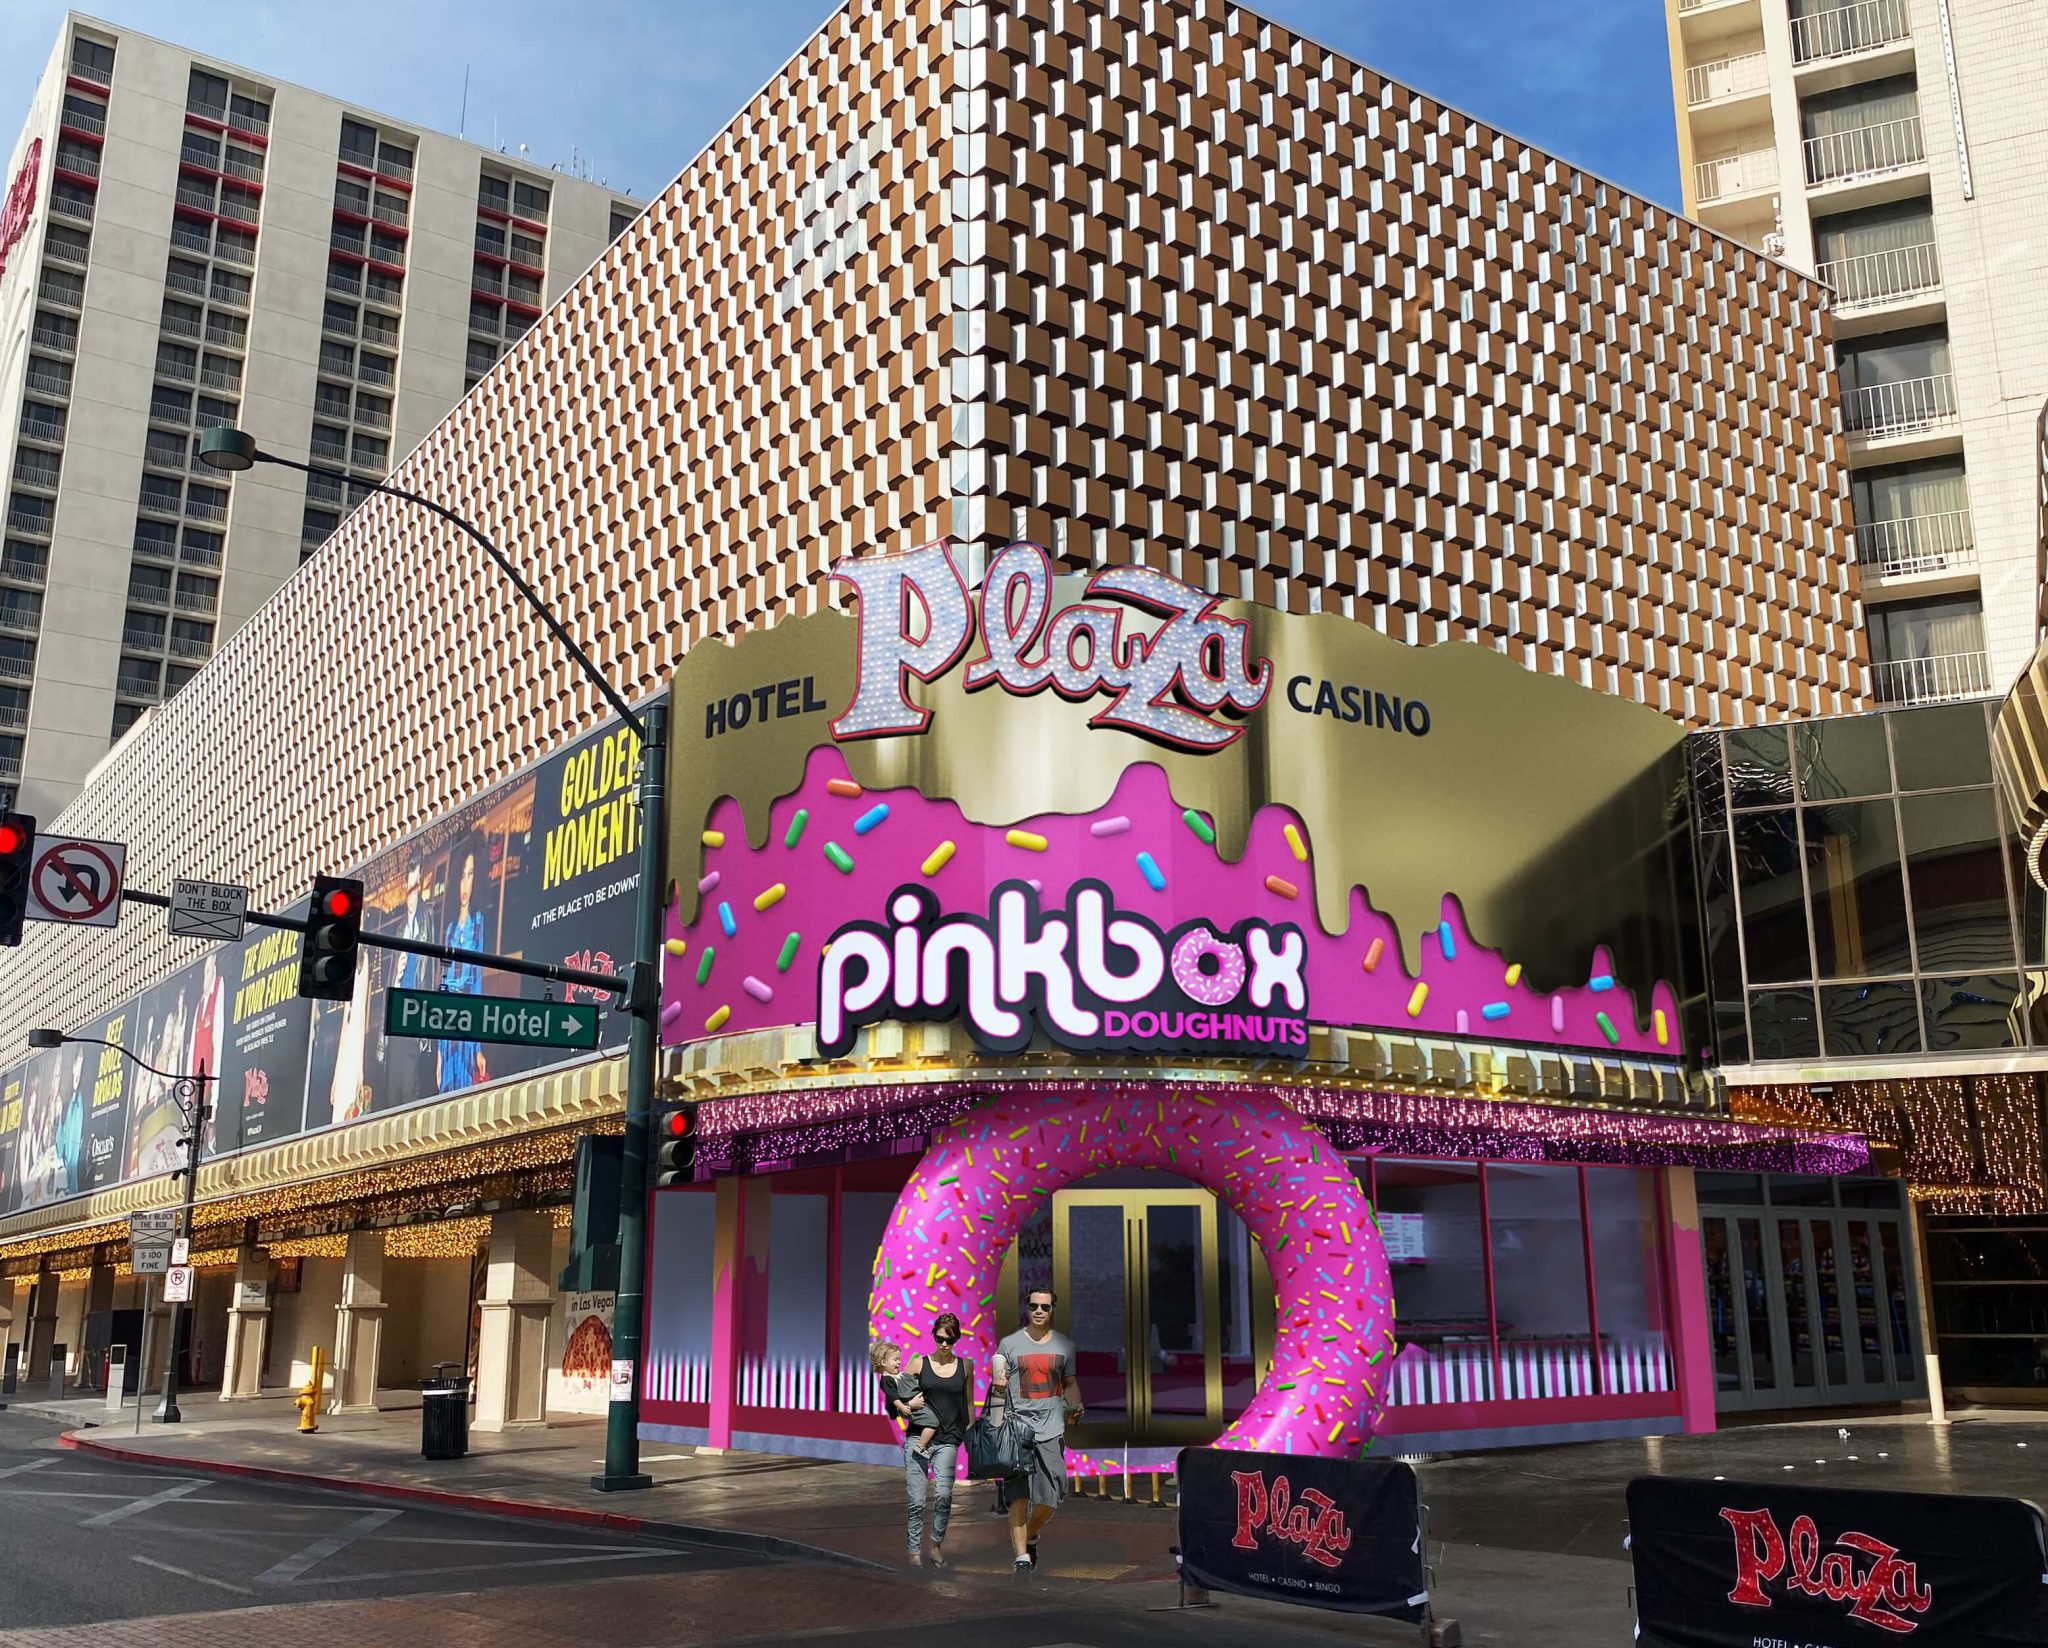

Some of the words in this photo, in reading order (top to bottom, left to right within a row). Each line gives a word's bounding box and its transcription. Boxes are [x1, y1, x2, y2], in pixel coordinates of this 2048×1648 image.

[705, 676, 827, 739] HOTEL
[827, 536, 1274, 753] Plaza
[1287, 675, 1431, 737] CASINO
[543, 790, 644, 891] MOMENT
[187, 897, 207, 910] THE
[212, 900, 232, 912] BOX
[211, 886, 243, 900] BLOCK
[531, 914, 541, 930] AT
[542, 907, 557, 925] THE
[557, 897, 582, 920] PLACE
[583, 893, 594, 910] TO
[595, 887, 607, 904] BE
[607, 873, 641, 898] DOWNT
[241, 942, 260, 983] THE
[256, 930, 282, 973] ODDS
[819, 887, 1306, 1046] pinkbox
[243, 976, 266, 1019] YOUR
[402, 998, 473, 1032] Plaza
[482, 1004, 550, 1038] Hotel
[1104, 1010, 1306, 1045] DOUGHNUTS
[155, 1220, 167, 1228] BOX
[141, 1261, 160, 1270] FINE
[571, 1297, 578, 1312] in
[579, 1299, 591, 1311] Las
[592, 1294, 614, 1313] Vegas
[1230, 1470, 1352, 1567] Plaza
[1248, 1572, 1269, 1583] HOTEL
[1278, 1576, 1307, 1589] CASINO
[1315, 1581, 1341, 1594] BINGO
[1719, 1507, 1932, 1632] Plaza
[1753, 1636, 1787, 1648] HOTEL
